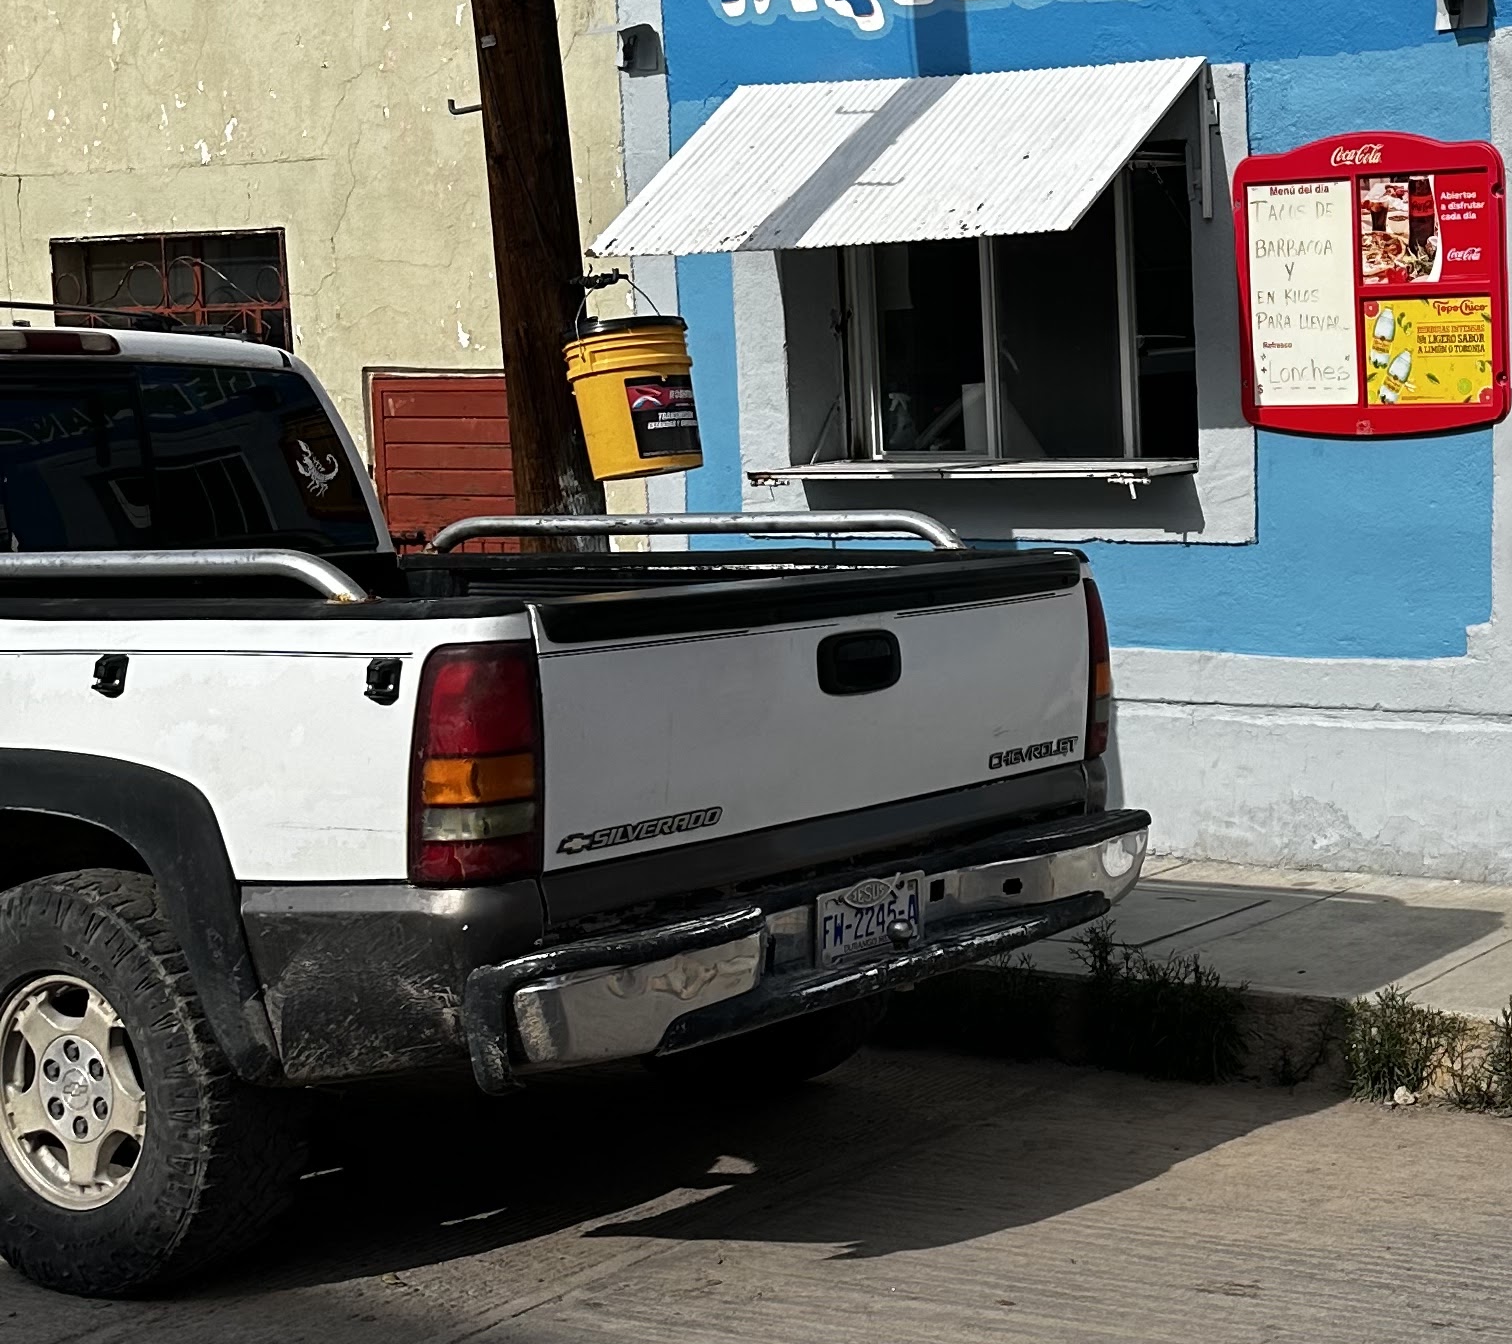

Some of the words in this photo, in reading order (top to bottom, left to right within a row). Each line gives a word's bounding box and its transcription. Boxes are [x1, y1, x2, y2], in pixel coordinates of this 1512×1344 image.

[1269, 186, 1295, 196] Menú
[1298, 185, 1312, 194] del
[1440, 212, 1461, 221] cada
[1255, 238, 1333, 259] BARBACOA
[1284, 261, 1295, 281] Y
[1257, 291, 1275, 304] EN
[1256, 311, 1291, 330] PARA
[1458, 333, 1485, 343] SABOR
[989, 736, 1079, 769] CHEVROLET
[590, 806, 723, 850] SILVERADO
[852, 883, 885, 903] JESUS
